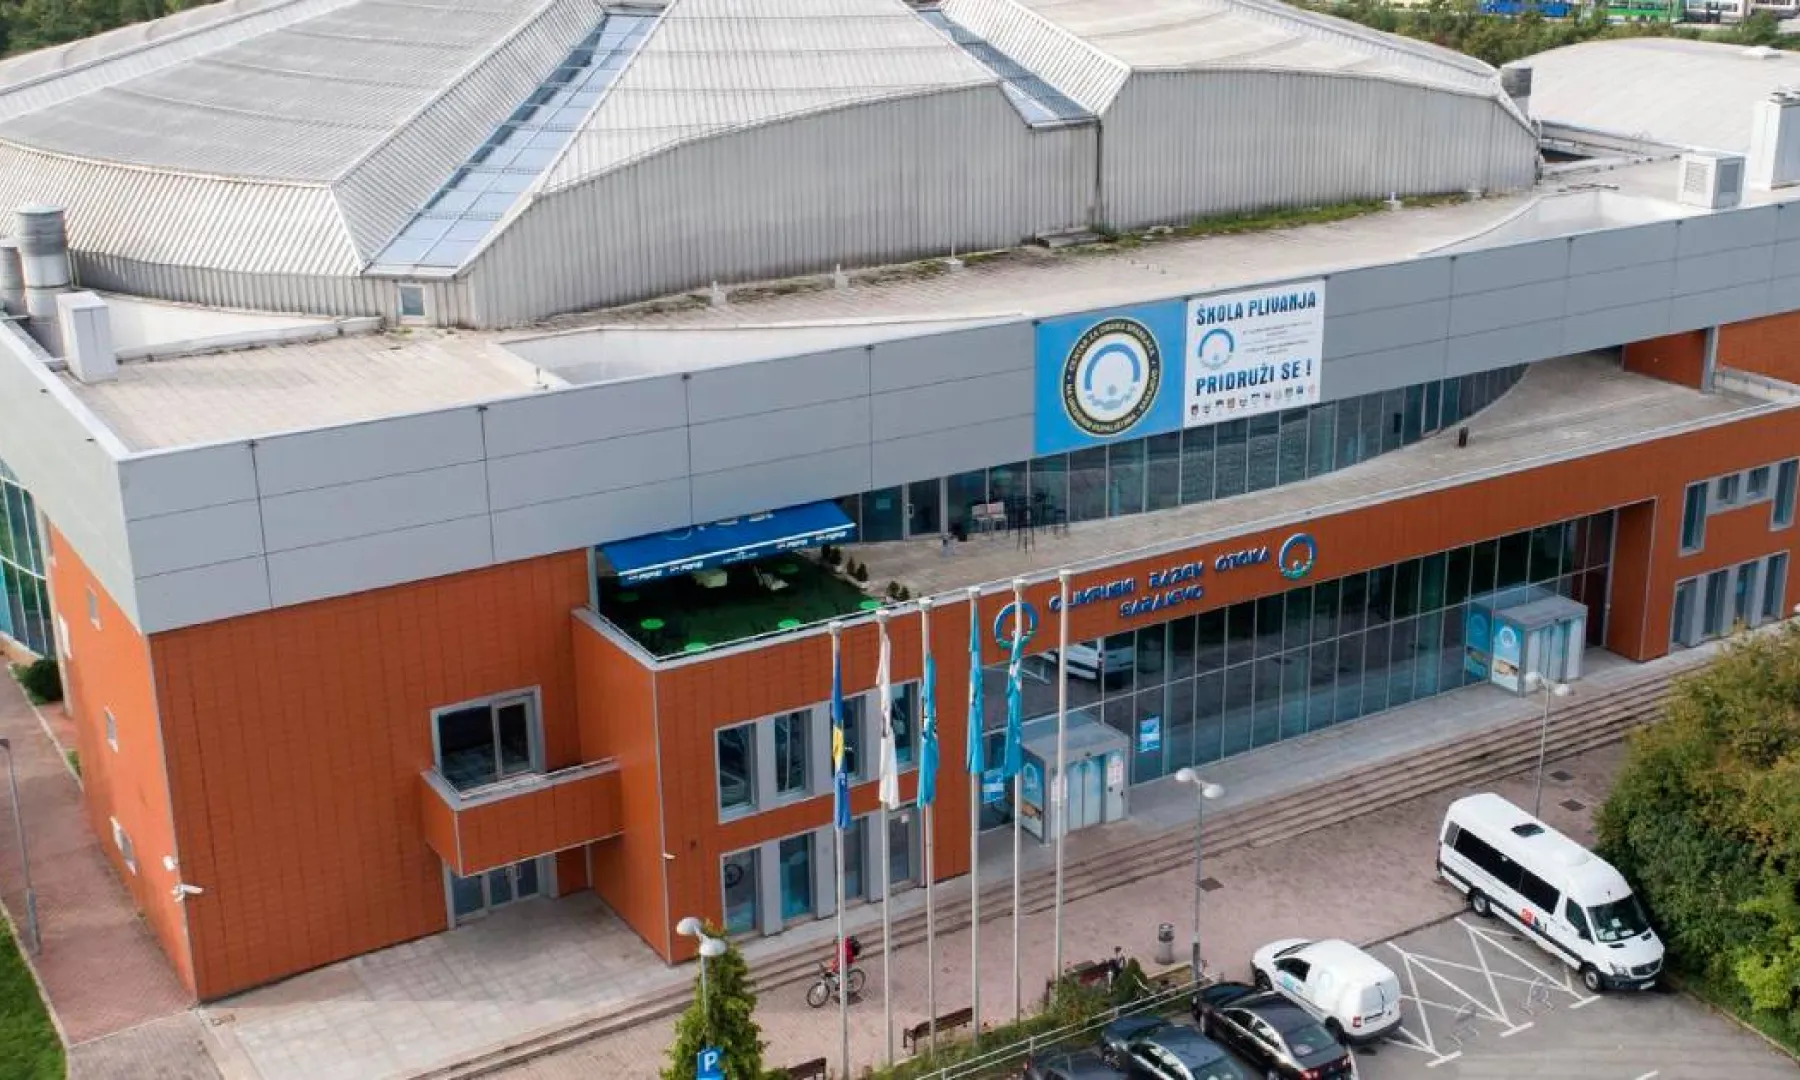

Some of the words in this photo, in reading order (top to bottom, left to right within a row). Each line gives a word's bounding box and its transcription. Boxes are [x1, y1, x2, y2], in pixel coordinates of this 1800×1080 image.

[1196, 302, 1243, 326] ŠKOLA
[1248, 290, 1316, 317] PLIVANJA
[1196, 362, 1275, 396] PRIDRUŽI
[1281, 360, 1301, 380] SE
[704, 1051, 718, 1072] P
